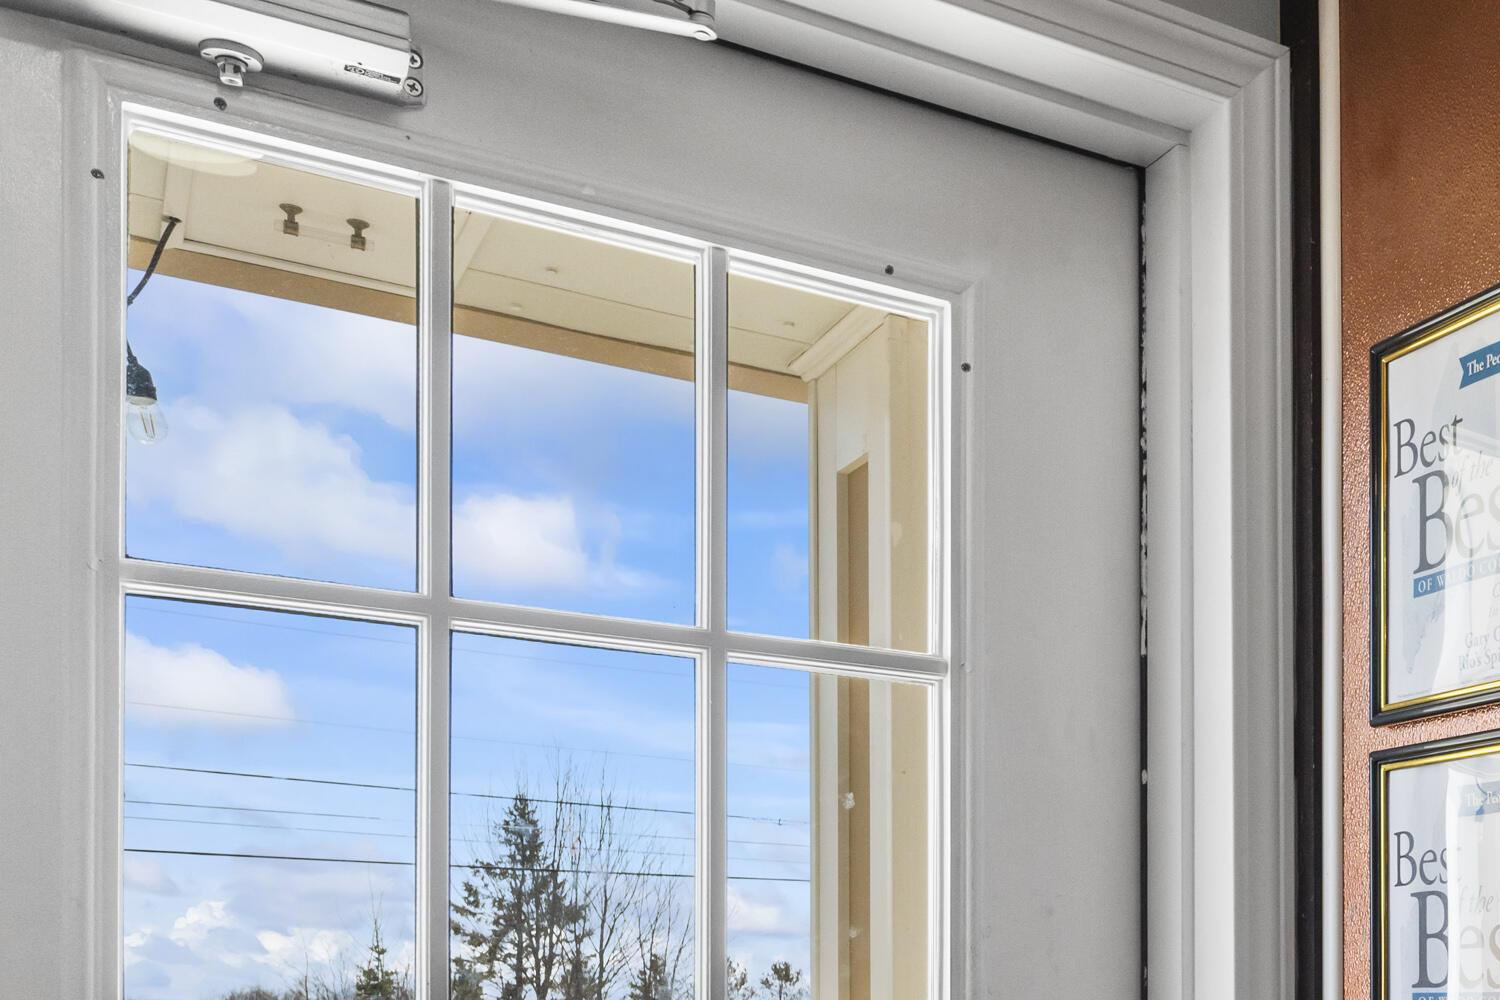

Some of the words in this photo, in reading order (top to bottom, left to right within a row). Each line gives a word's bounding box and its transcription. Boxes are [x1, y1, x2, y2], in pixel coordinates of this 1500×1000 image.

[1466, 360, 1484, 377] The
[1394, 415, 1463, 478] Best
[1418, 578, 1433, 594] OF
[1394, 831, 1449, 887] Bes
